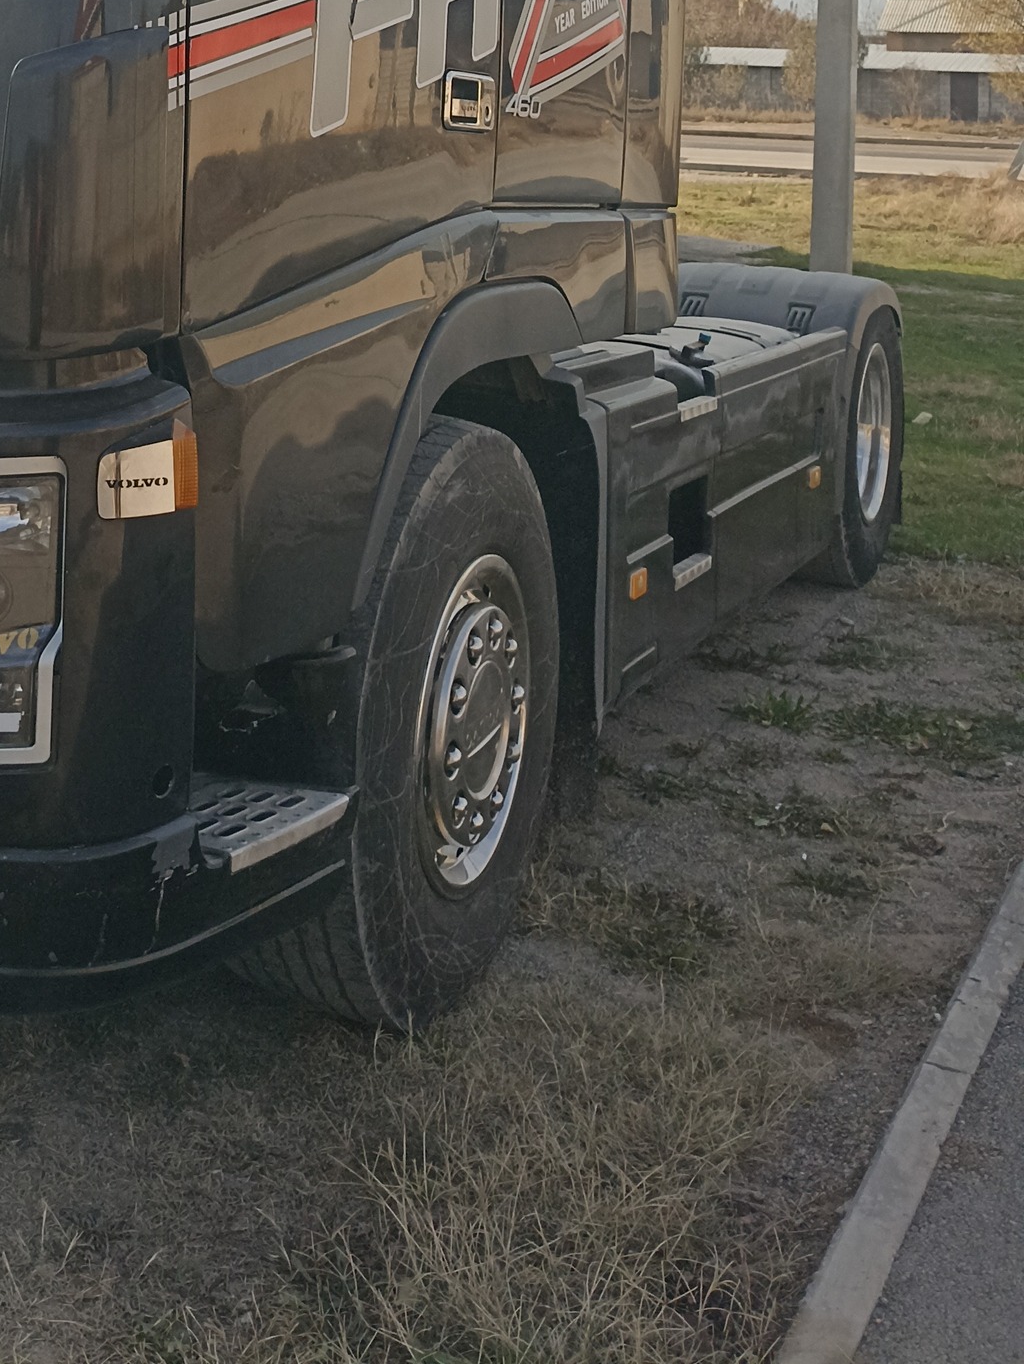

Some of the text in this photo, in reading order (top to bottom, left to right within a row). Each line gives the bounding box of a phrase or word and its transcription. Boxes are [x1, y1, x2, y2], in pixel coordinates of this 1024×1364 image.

[554, 8, 576, 34] YEAR
[505, 93, 542, 120] 460
[105, 477, 169, 489] VOLVO
